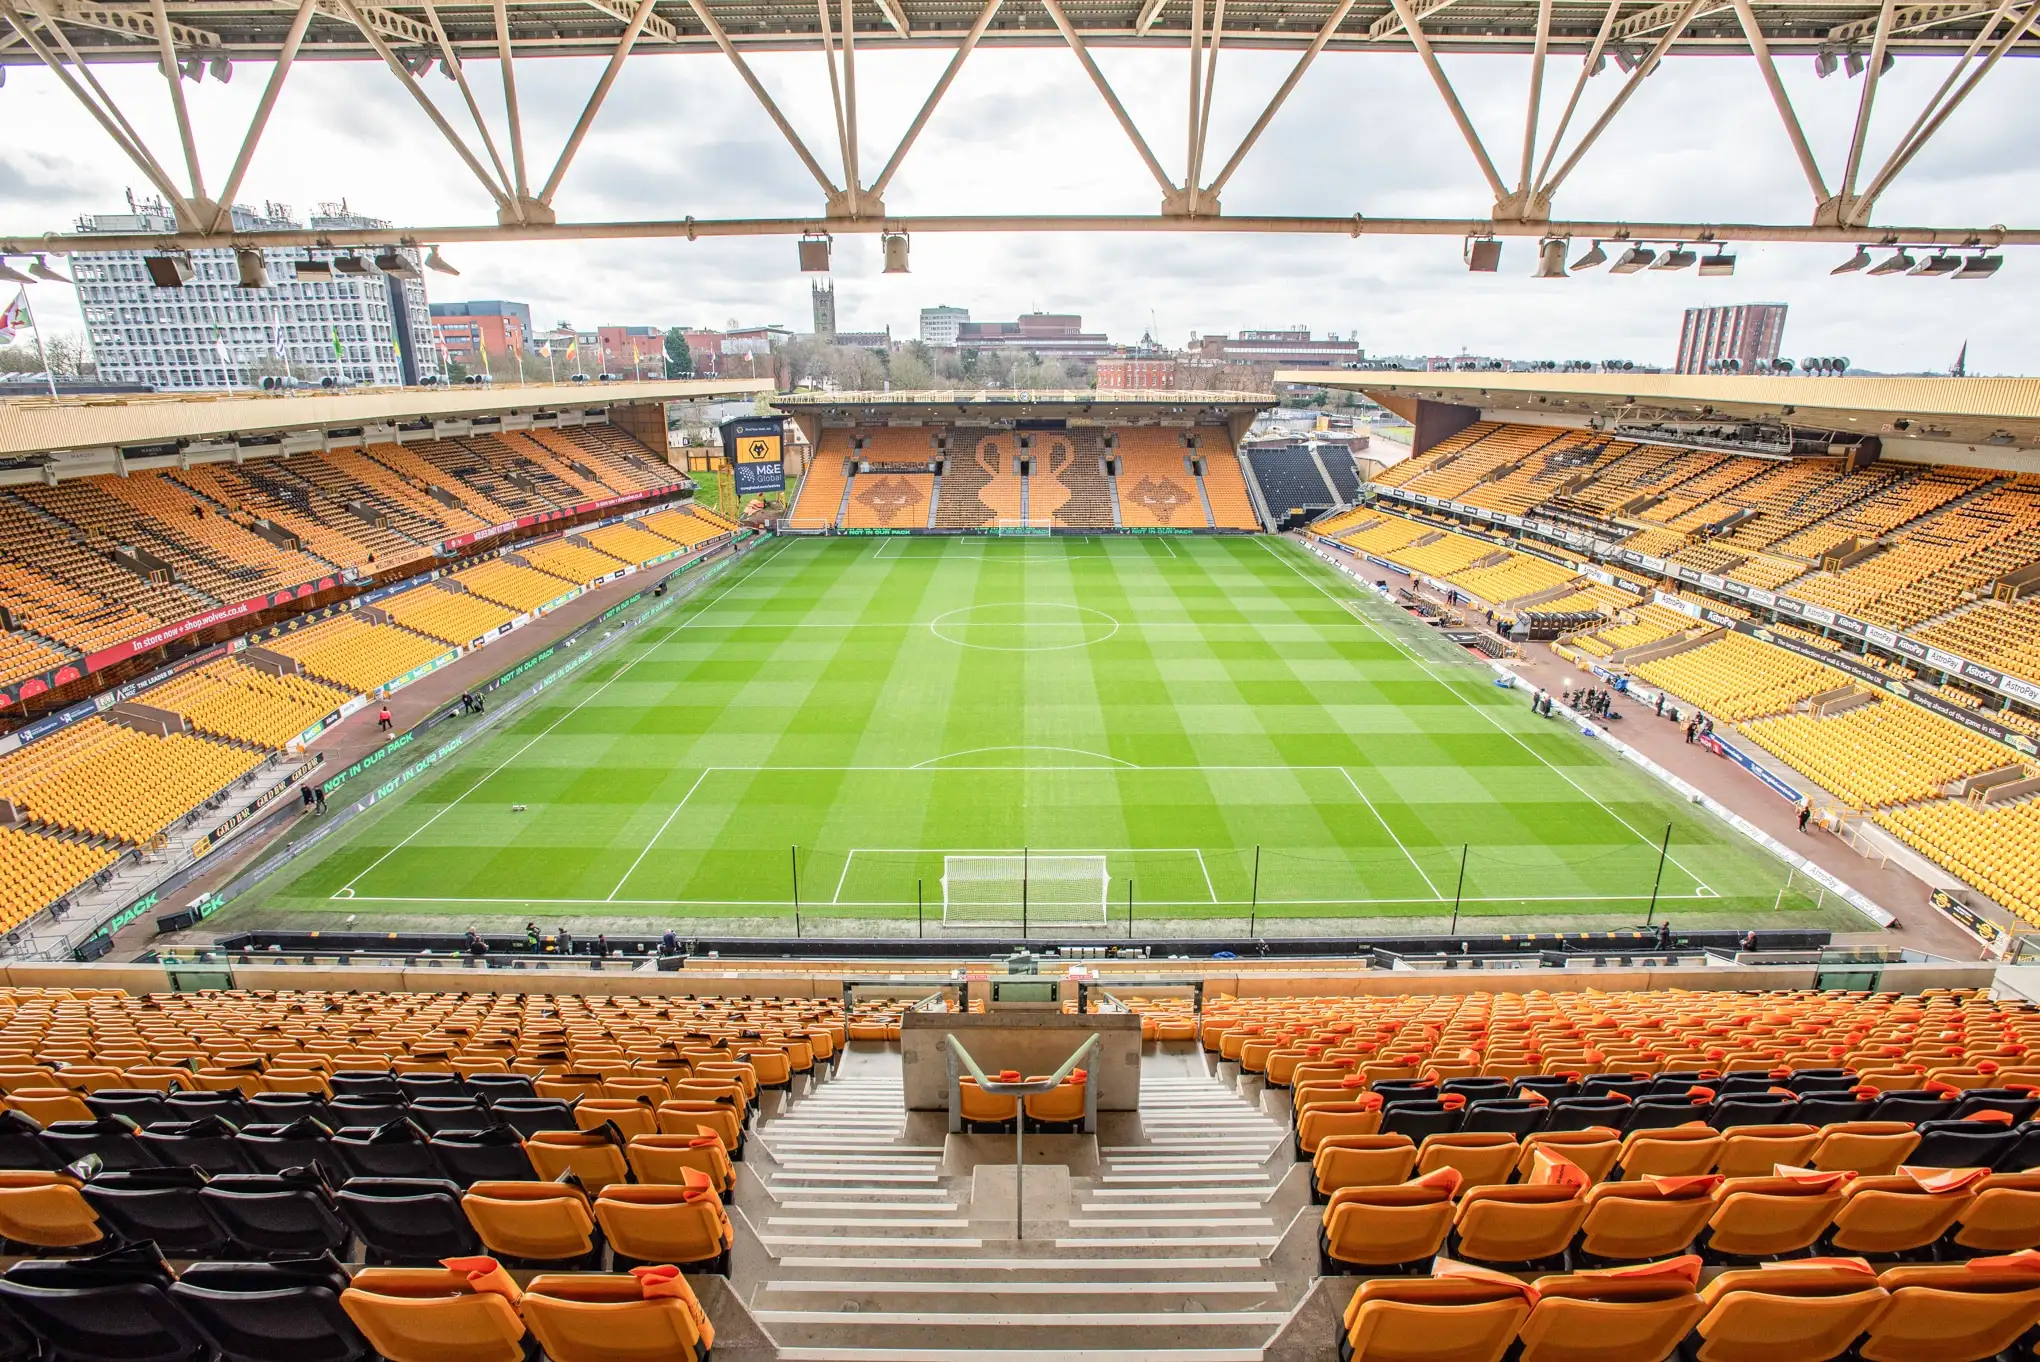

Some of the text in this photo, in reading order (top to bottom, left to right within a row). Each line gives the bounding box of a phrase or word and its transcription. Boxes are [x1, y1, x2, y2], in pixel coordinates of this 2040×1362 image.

[756, 464, 781, 475] M&E
[757, 474, 782, 483] Global
[1680, 568, 1700, 580] AstroPay
[1618, 579, 1641, 595] AstroPay
[1725, 582, 1747, 596] AstroPay
[1752, 589, 1771, 602] AstroPay
[605, 608, 616, 619] NOT
[620, 600, 630, 610] OUR
[629, 593, 641, 604] PACK
[1662, 594, 1686, 612] AstroPay
[1777, 598, 1801, 612] AstroPay
[1707, 611, 1737, 630] AstroPay
[1807, 607, 1832, 622] AstroPay
[132, 640, 143, 652] In
[143, 634, 163, 648] store
[163, 627, 178, 640] now
[184, 602, 248, 631] shop.wolves.co.uk
[1838, 617, 1863, 633] AstroPay
[1870, 627, 1893, 644] AstroPay
[1898, 640, 1925, 656] AstroPay
[136, 647, 226, 689] THE LEADER IN SECURITY OPERATIONS
[435, 652, 454, 666] bet365
[500, 647, 555, 685] NOT IN OUR PACK
[542, 649, 594, 688] NOT IN OUR PACK
[1777, 638, 1786, 646] The
[1785, 642, 1801, 655] largest
[1800, 647, 1821, 660] selection
[1820, 652, 1826, 661] of
[1826, 656, 1836, 665] wall
[1835, 659, 1840, 667] &
[1840, 662, 1851, 671] floor
[1851, 665, 1861, 674] tiles
[1866, 671, 1874, 680] the
[1874, 676, 1882, 684] UK
[1931, 651, 1959, 669] AstroPay
[412, 663, 433, 678] bet365
[1965, 665, 1998, 684] AstroPay
[388, 674, 410, 690] bet365
[2005, 680, 2038, 699] AstroPay
[1913, 693, 2002, 738] Staying ahead of the game in tiles
[291, 757, 319, 782] GOLD BAR
[322, 731, 415, 794] NOT IN OUR PACK
[376, 735, 464, 799] NOT IN OUR PACK
[255, 780, 288, 808] GOLD BAR
[215, 807, 251, 838] GOLD BAR
[1737, 819, 1761, 838] AstroPay
[1809, 867, 1839, 889] AstroPay
[111, 890, 159, 933] PACK
[200, 892, 226, 917] CK
[1850, 894, 1884, 919] AstroPay
